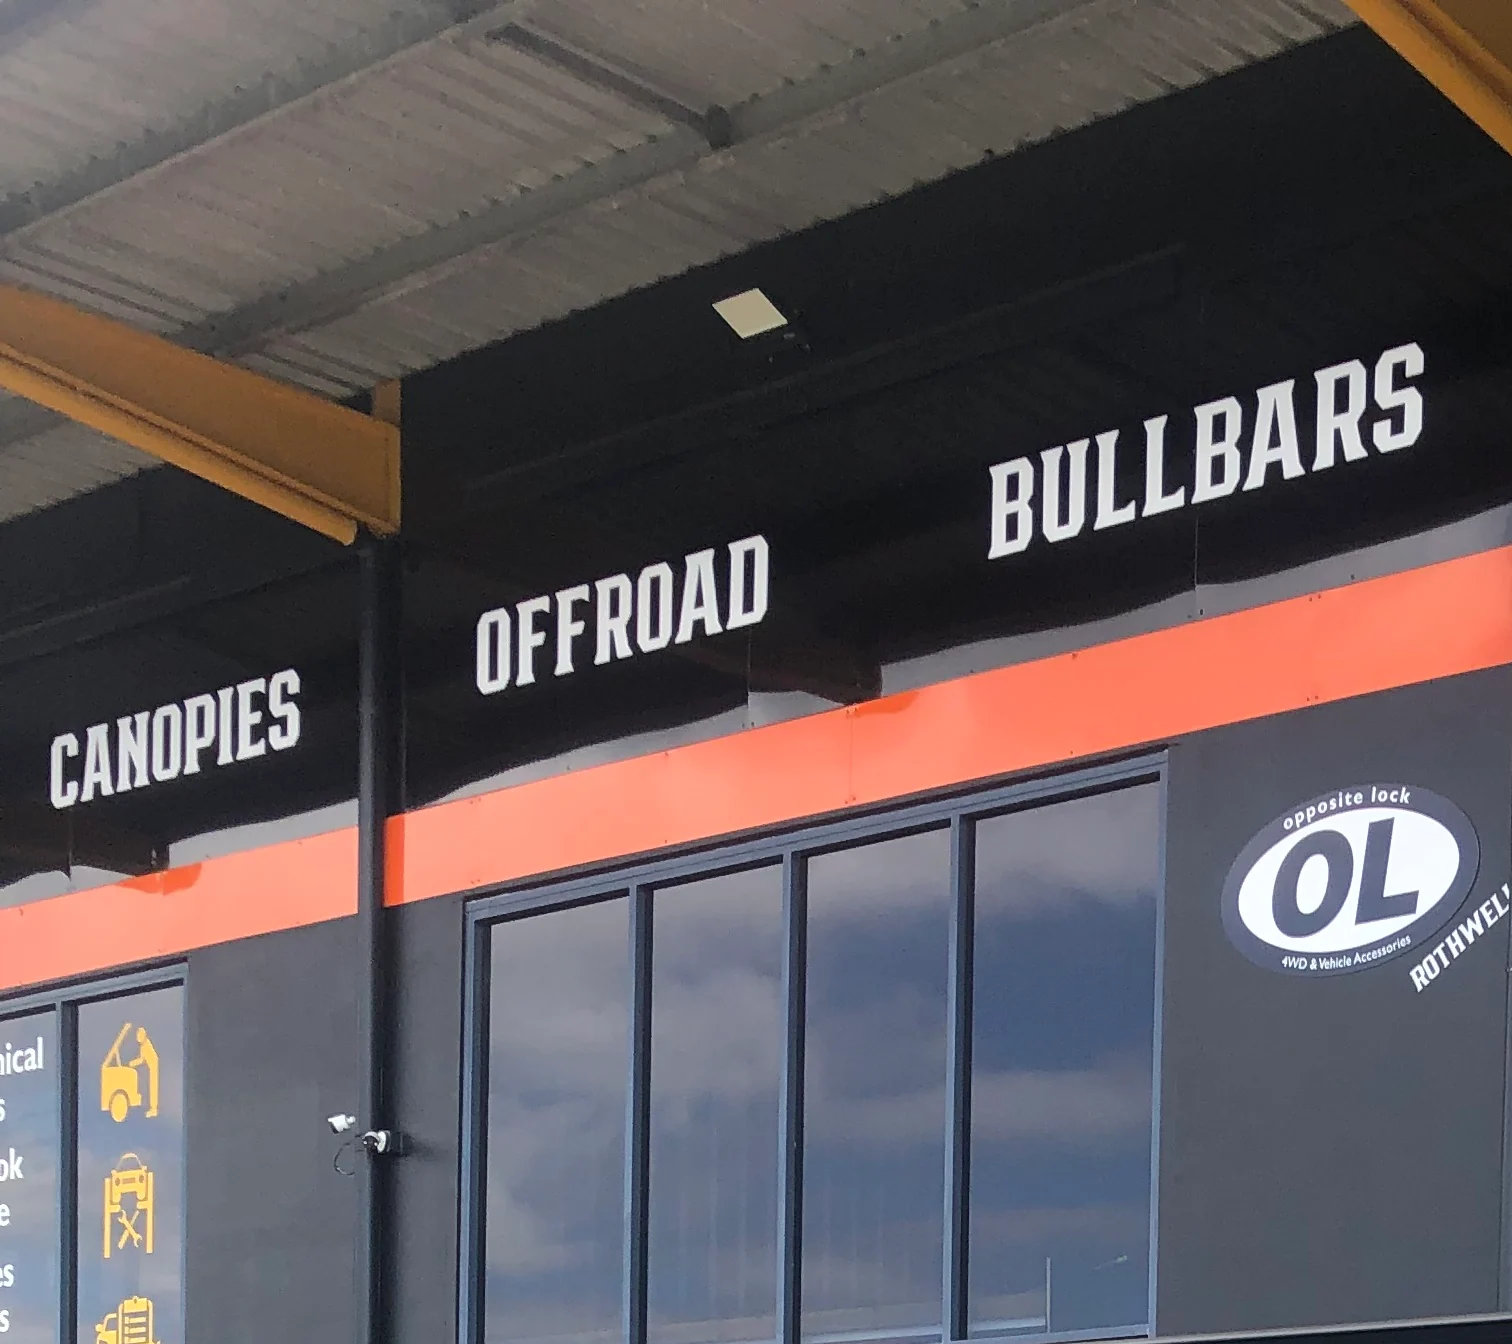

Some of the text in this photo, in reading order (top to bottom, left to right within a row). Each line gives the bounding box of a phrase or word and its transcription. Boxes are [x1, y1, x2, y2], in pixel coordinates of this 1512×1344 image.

[987, 343, 1424, 559] BULLBARS
[477, 535, 769, 695] OFFROAD
[50, 669, 301, 809] CANOPIES
[1283, 786, 1410, 830] opposite lock
[1272, 817, 1419, 938] OL
[1282, 934, 1412, 970] 4WD & Vehicle Accessories
